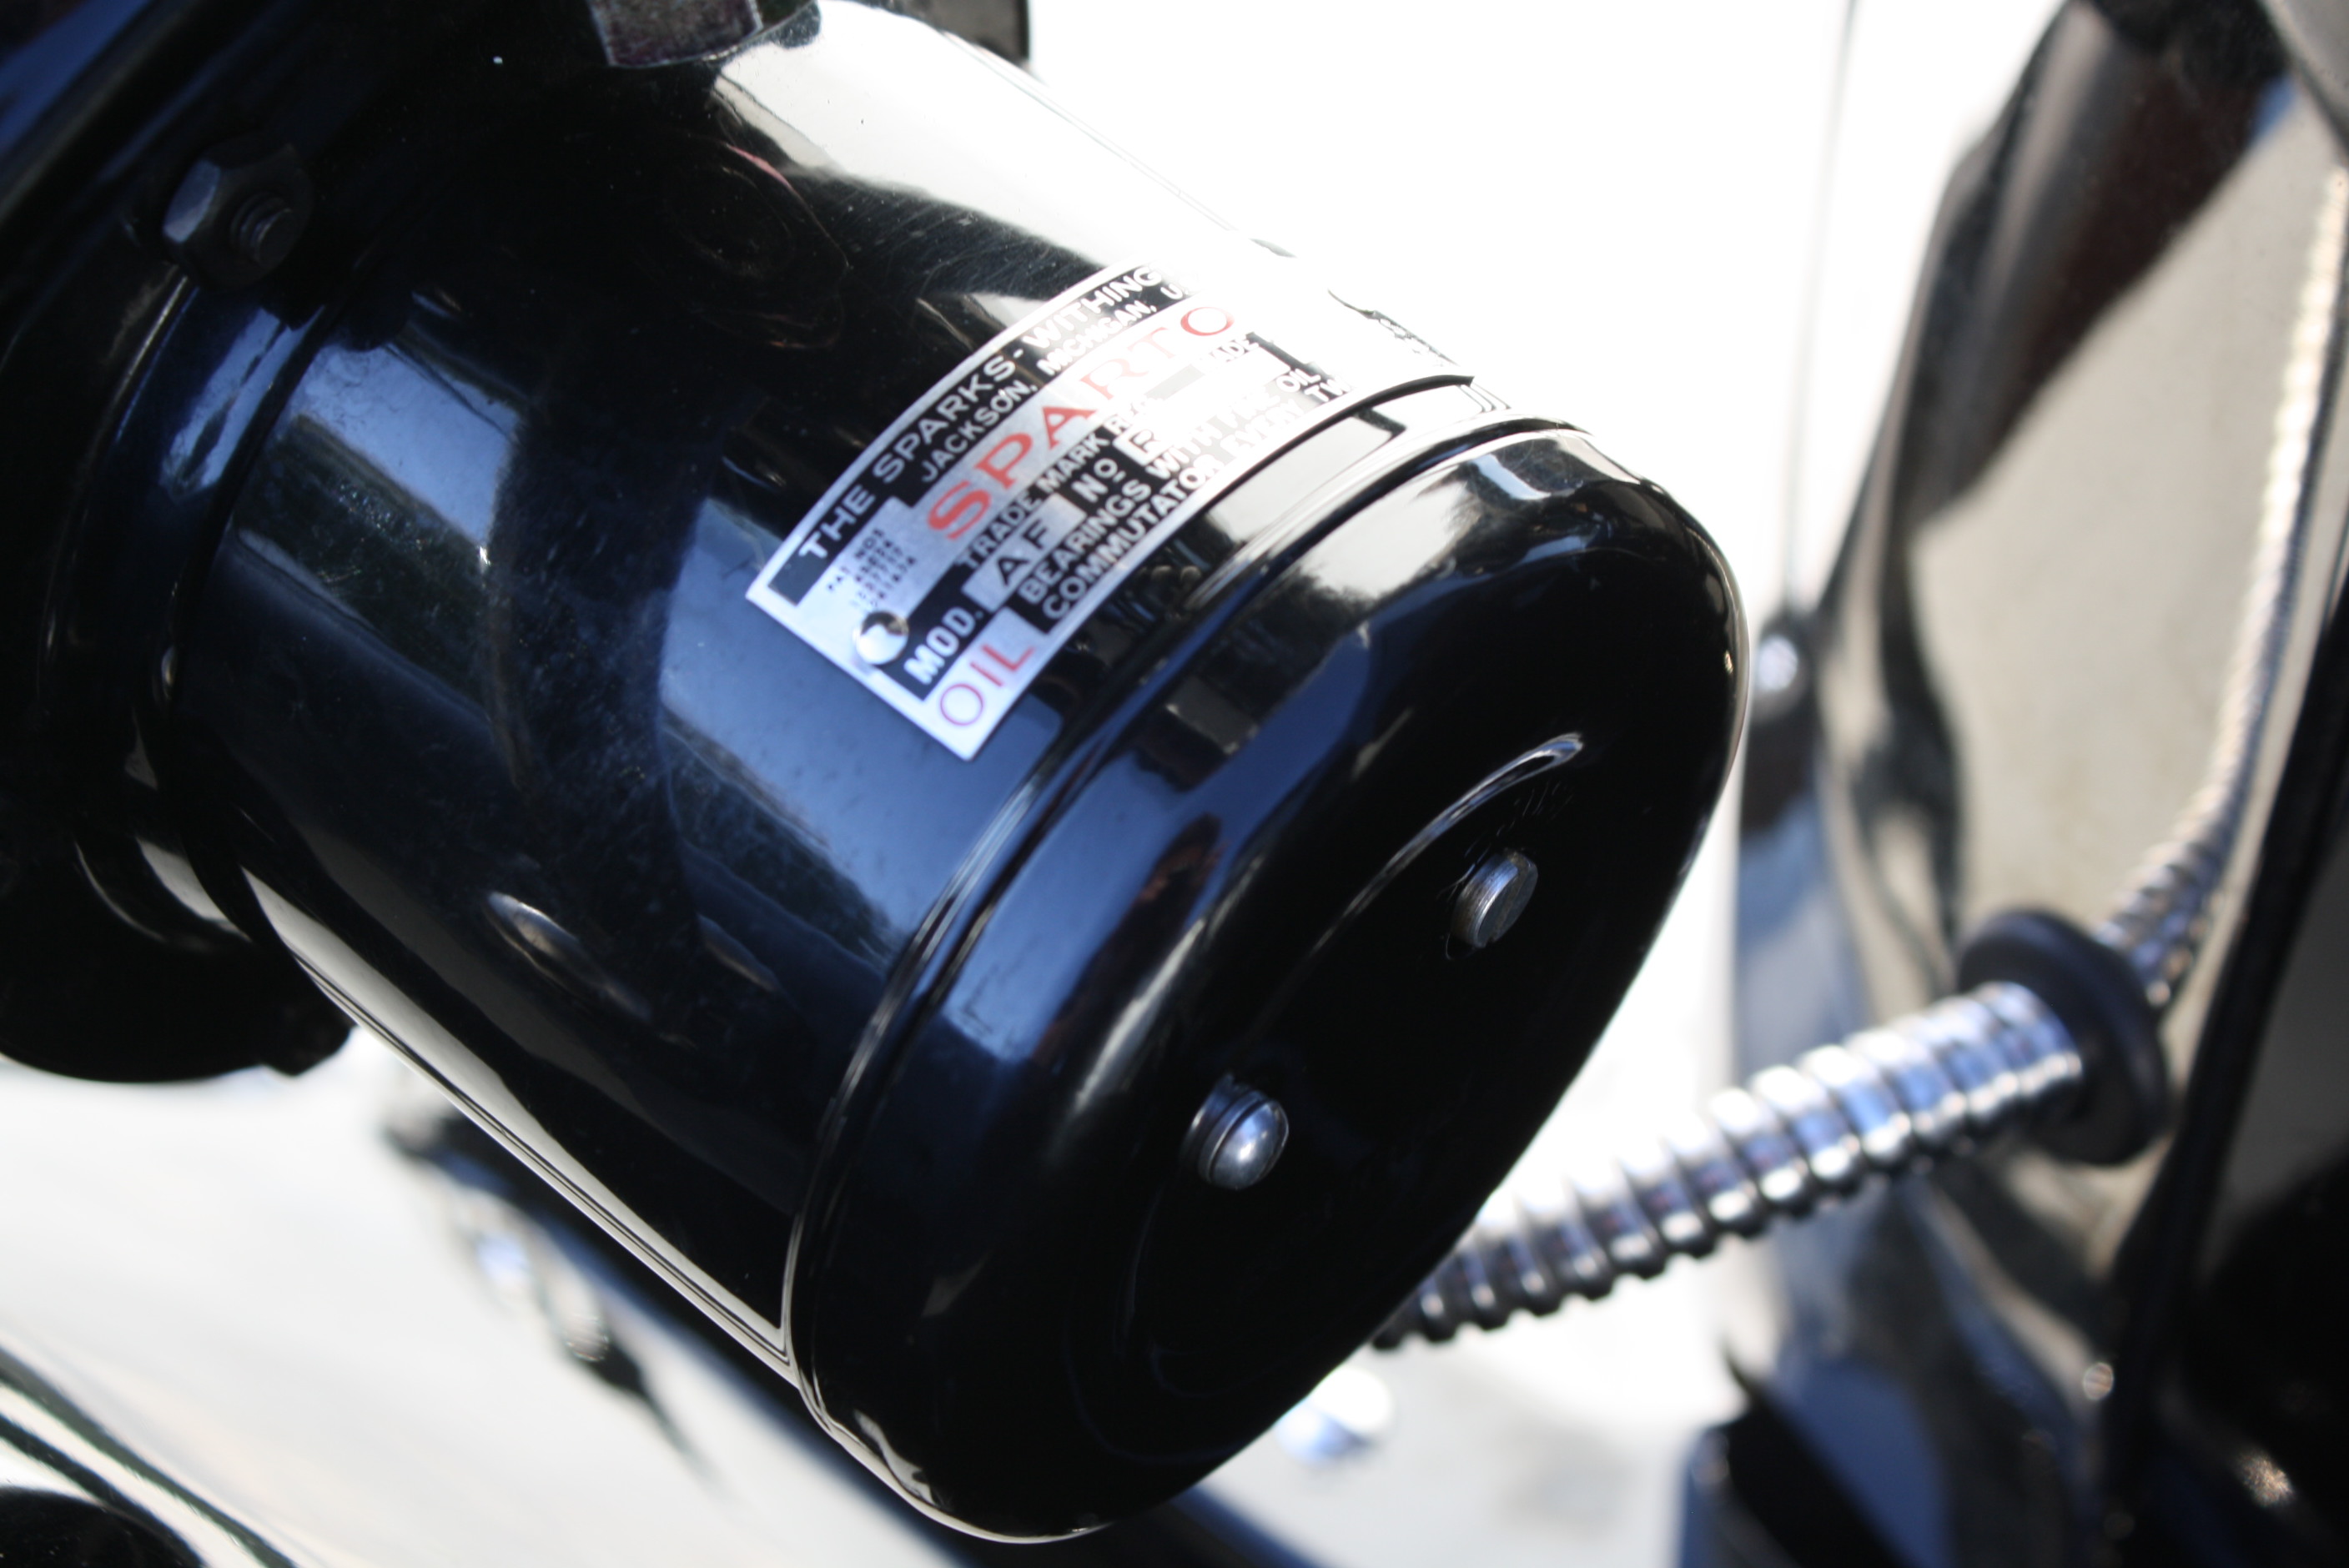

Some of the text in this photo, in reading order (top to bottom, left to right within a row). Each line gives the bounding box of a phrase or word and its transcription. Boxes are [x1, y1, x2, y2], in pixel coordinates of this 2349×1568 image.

[926, 306, 1235, 540] SPARTO
[962, 489, 1044, 569] TRADE
[1035, 432, 1112, 494] MARK
[1043, 453, 1225, 619] COMMUTATOR
[1305, 374, 1352, 402] TW
[798, 485, 875, 558] THE
[940, 644, 1035, 726] OIL
[1017, 478, 1151, 605] BEARINGS
[1145, 423, 1223, 480] WITH
[1276, 369, 1320, 393] OIL
[903, 606, 983, 685] MOD.
